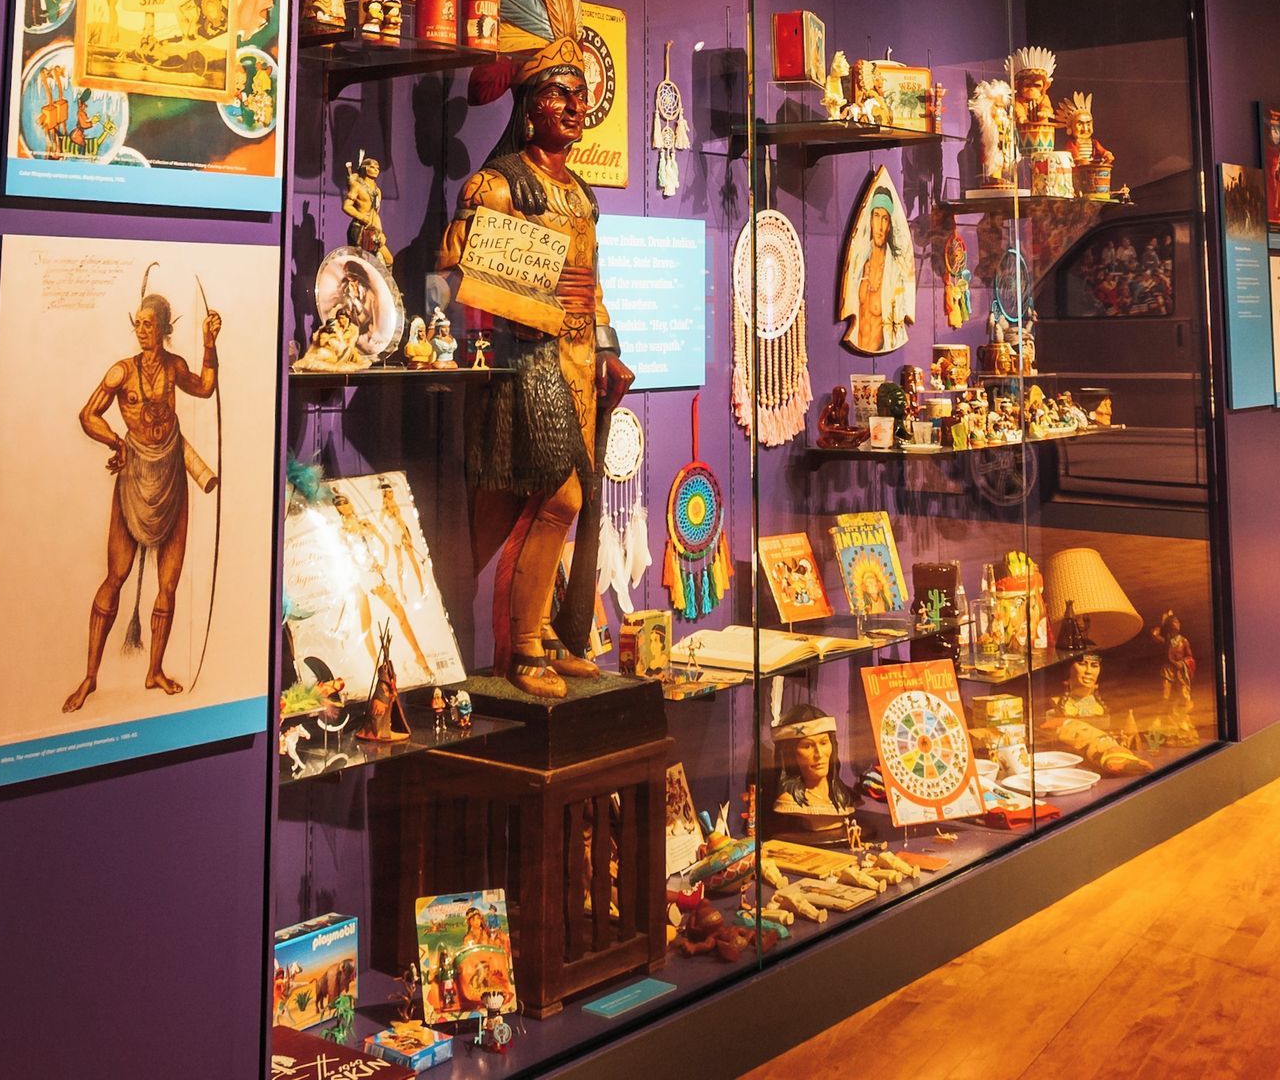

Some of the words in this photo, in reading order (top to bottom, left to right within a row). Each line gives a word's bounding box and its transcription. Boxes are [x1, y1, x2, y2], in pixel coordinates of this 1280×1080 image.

[898, 81, 923, 92] WEST
[567, 142, 622, 168] ndian
[469, 233, 514, 249] CHIEF
[539, 233, 551, 246] &
[509, 247, 561, 273] CIGARS
[835, 530, 887, 549] INDIAN
[867, 673, 880, 696] 10
[880, 671, 908, 681] LITTLE
[923, 669, 954, 690] Puzzle
[312, 923, 357, 951] playmobil
